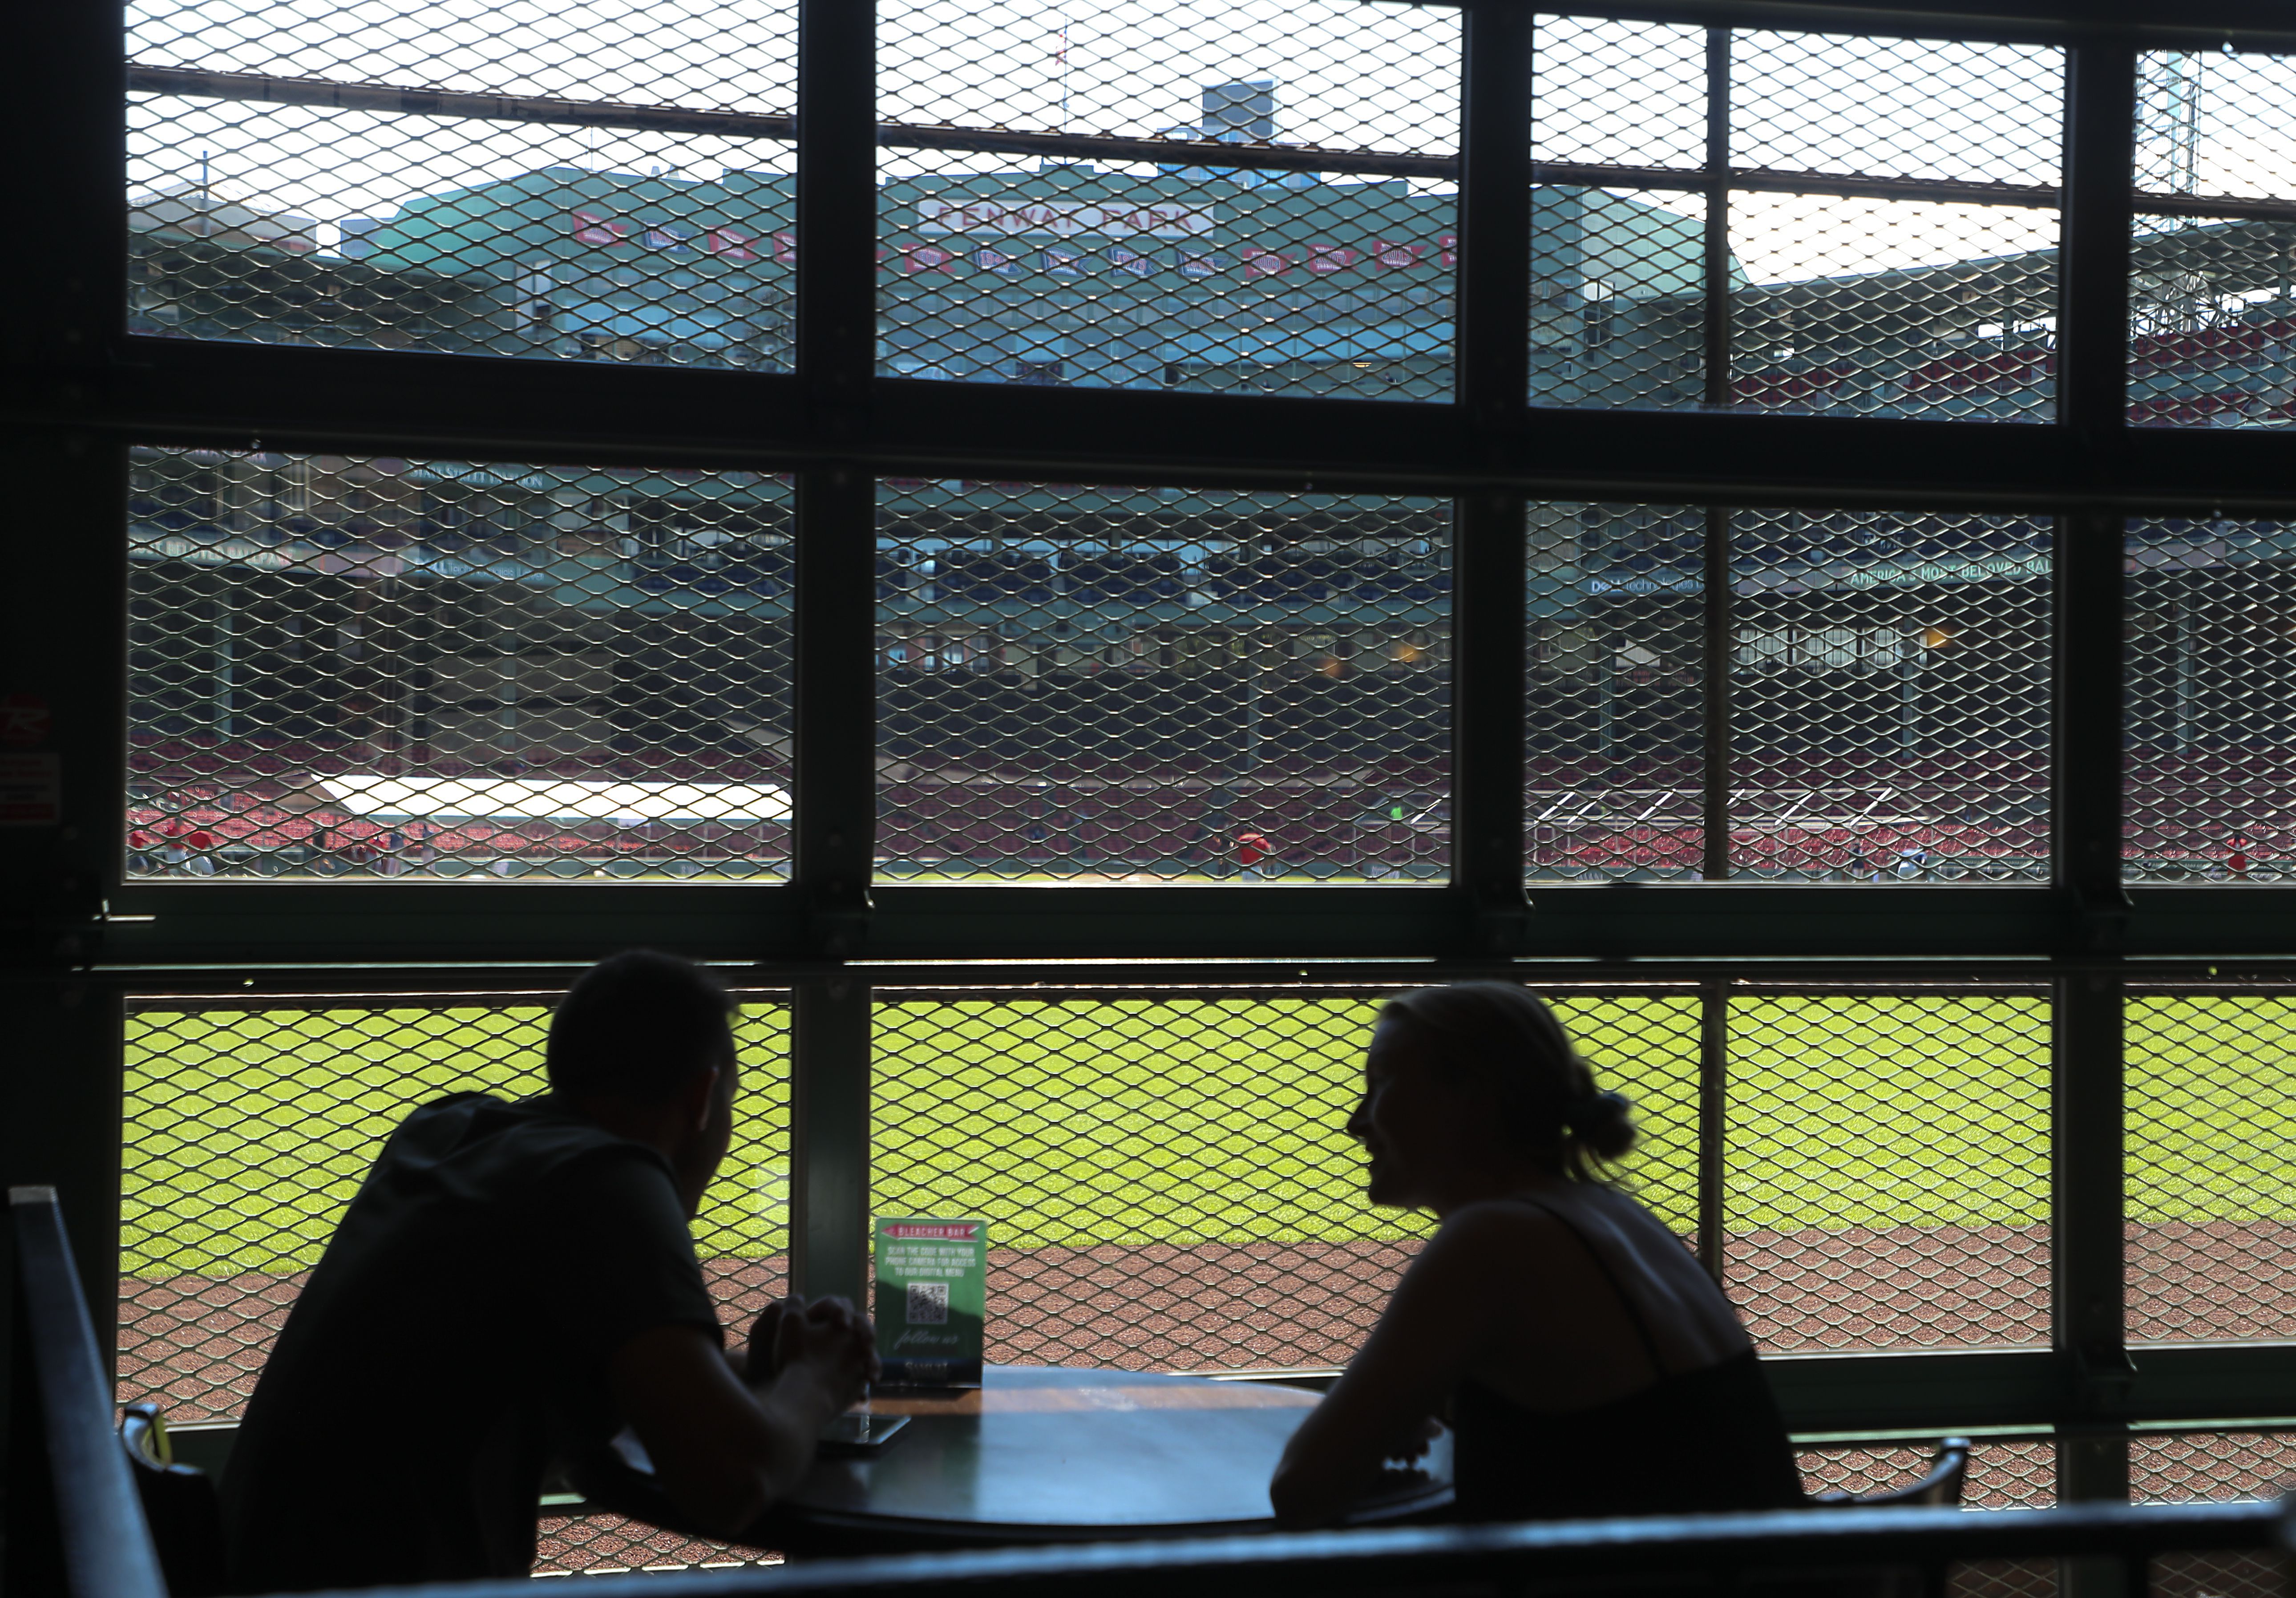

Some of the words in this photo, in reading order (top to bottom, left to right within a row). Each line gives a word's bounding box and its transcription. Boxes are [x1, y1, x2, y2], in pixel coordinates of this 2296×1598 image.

[939, 207, 1077, 228] FENWAY
[1102, 209, 1192, 229] PARK
[1851, 569, 1916, 585] AMERICA'S
[1921, 565, 1956, 579] MOST
[1961, 562, 2021, 578] BELOVED
[899, 1227, 945, 1236] BLEACHER
[948, 1228, 965, 1237] BAR
[888, 1246, 905, 1255] SCAN
[907, 1247, 919, 1255] THE
[921, 1247, 937, 1255] CODE
[939, 1247, 955, 1256] WITH
[957, 1247, 974, 1256] YOUR
[885, 1257, 906, 1266] PHONE
[908, 1258, 935, 1266] CAMERA
[938, 1258, 949, 1266] FOR
[951, 1258, 976, 1267] ACCESS
[895, 1267, 904, 1276] TO
[905, 1268, 918, 1276] OUR
[919, 1268, 943, 1277] DIGITAL
[945, 1268, 965, 1277] MENU
[894, 1329, 939, 1350] follow
[942, 1335, 958, 1344] us
